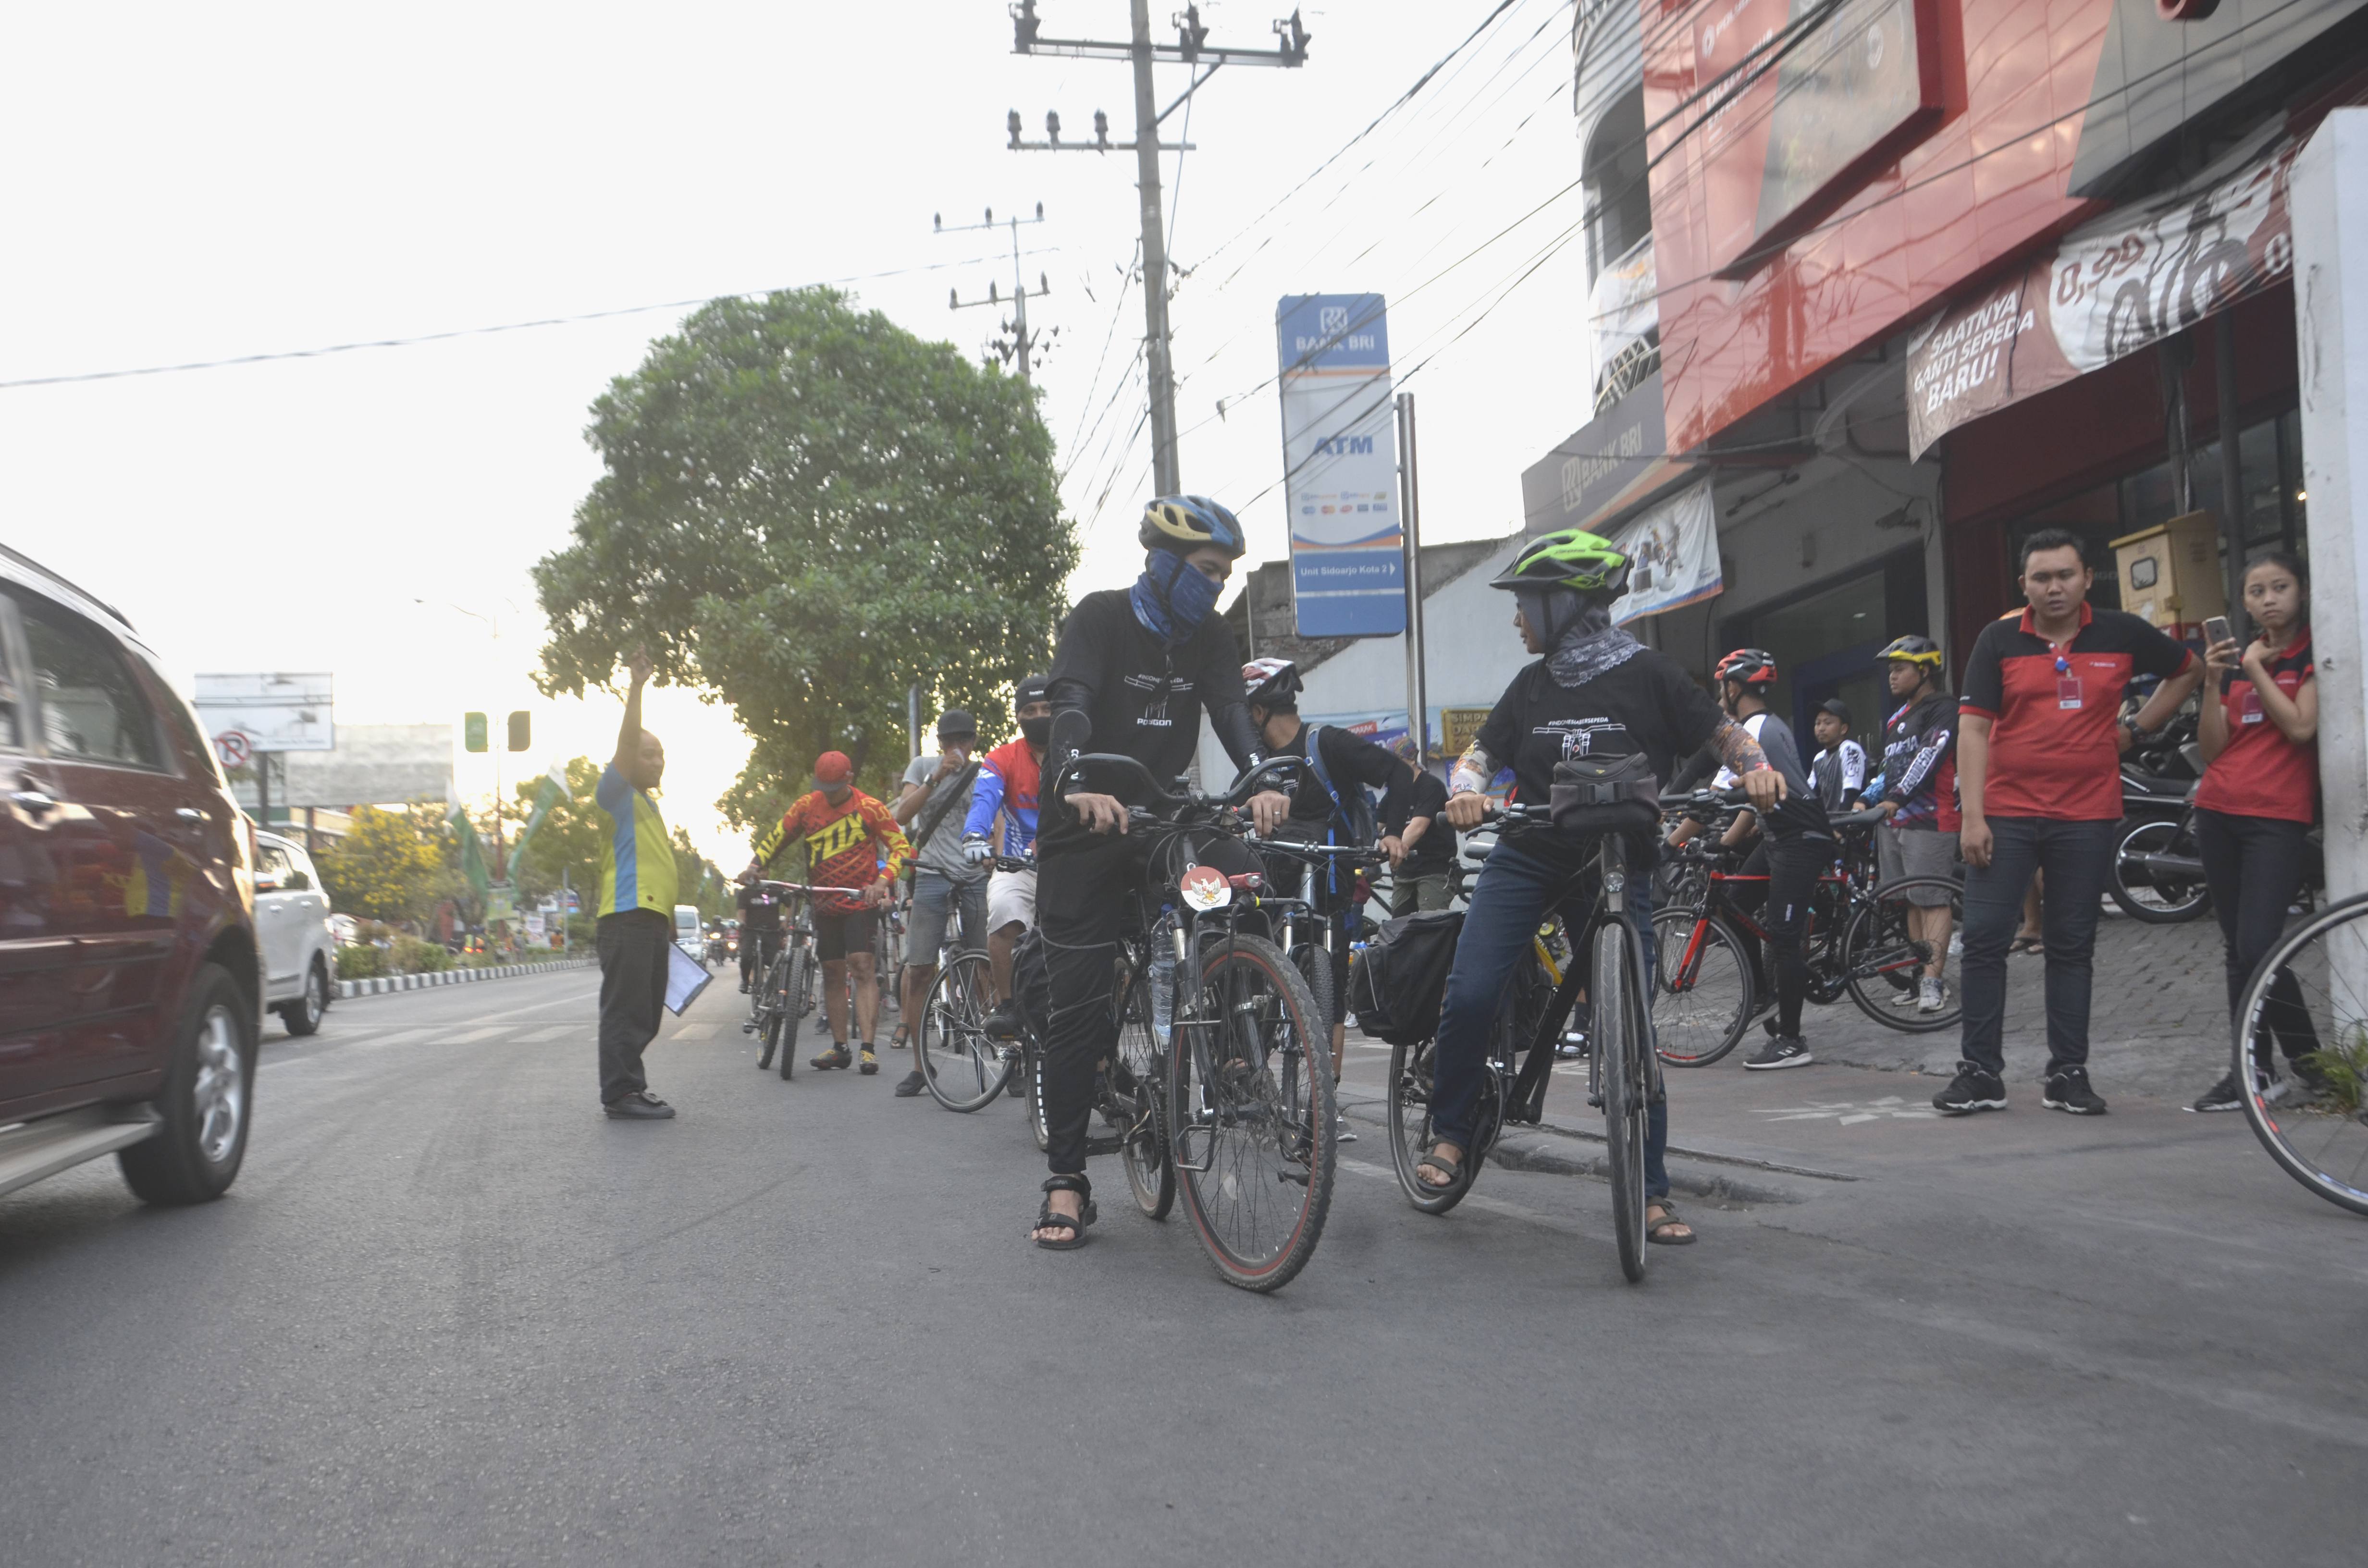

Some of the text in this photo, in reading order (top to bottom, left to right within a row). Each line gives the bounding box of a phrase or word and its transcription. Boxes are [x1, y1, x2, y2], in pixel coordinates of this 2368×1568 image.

[1930, 290, 2017, 359] SAATNYA
[1296, 335, 1375, 352] BANK BRI
[1914, 347, 1958, 393] GANTI
[1959, 309, 2034, 364] SEPEDA
[1926, 346, 2000, 416] BARU!
[1313, 436, 1373, 454] ATM
[1582, 421, 1642, 490] BANK BRI
[1300, 564, 1387, 576] Unit Sidoarjo Kota 2
[1451, 712, 1490, 722] SIMPA
[1548, 717, 1609, 726] #INDONESIABERSEPEDA
[805, 813, 867, 868] FOX
